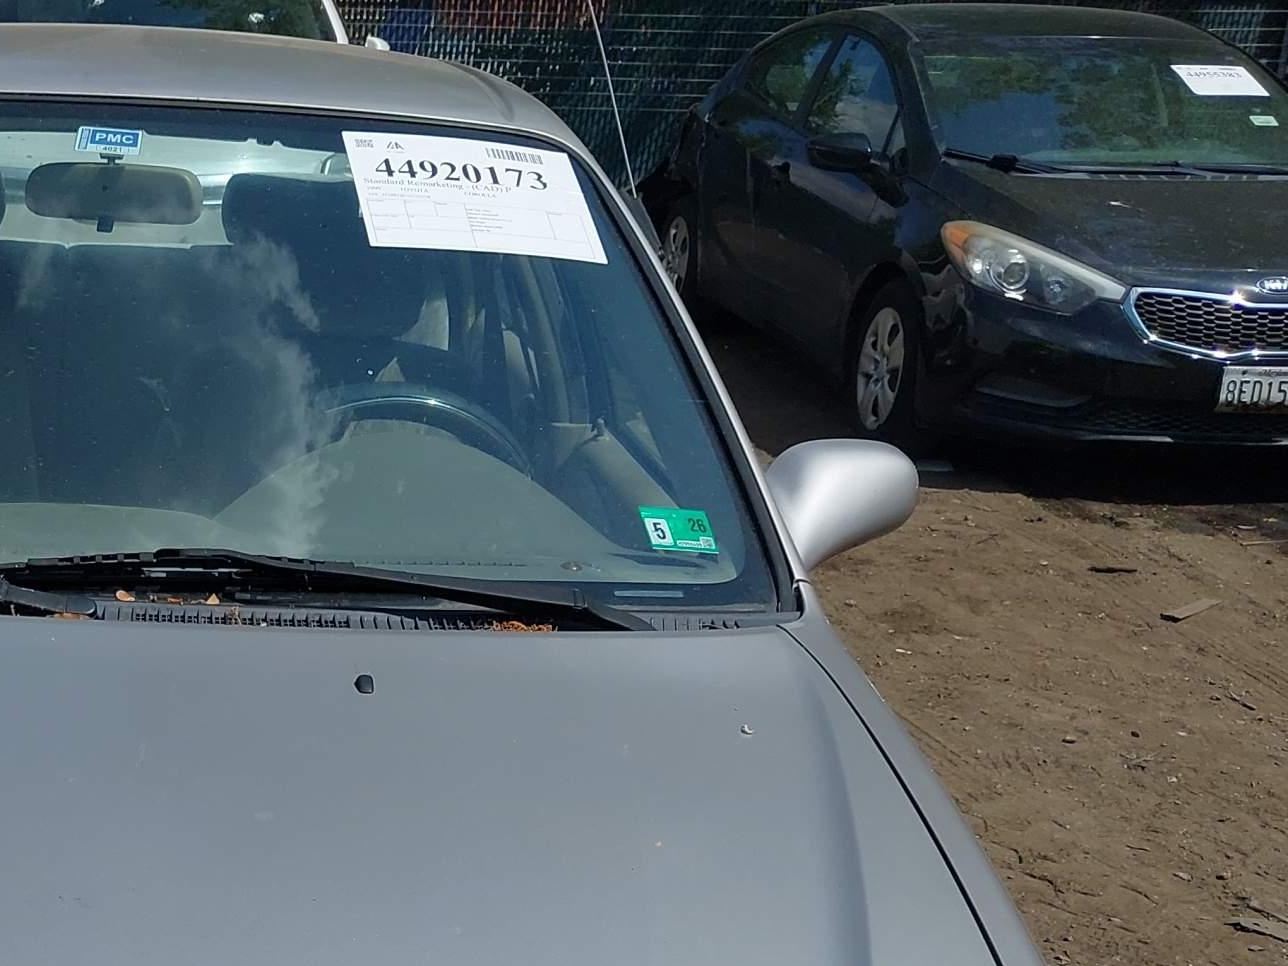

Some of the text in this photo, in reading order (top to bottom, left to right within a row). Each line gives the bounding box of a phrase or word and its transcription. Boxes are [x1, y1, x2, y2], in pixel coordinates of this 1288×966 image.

[95, 132, 134, 144] PMC
[375, 158, 548, 191] 44920173
[652, 518, 707, 540] 5 26
